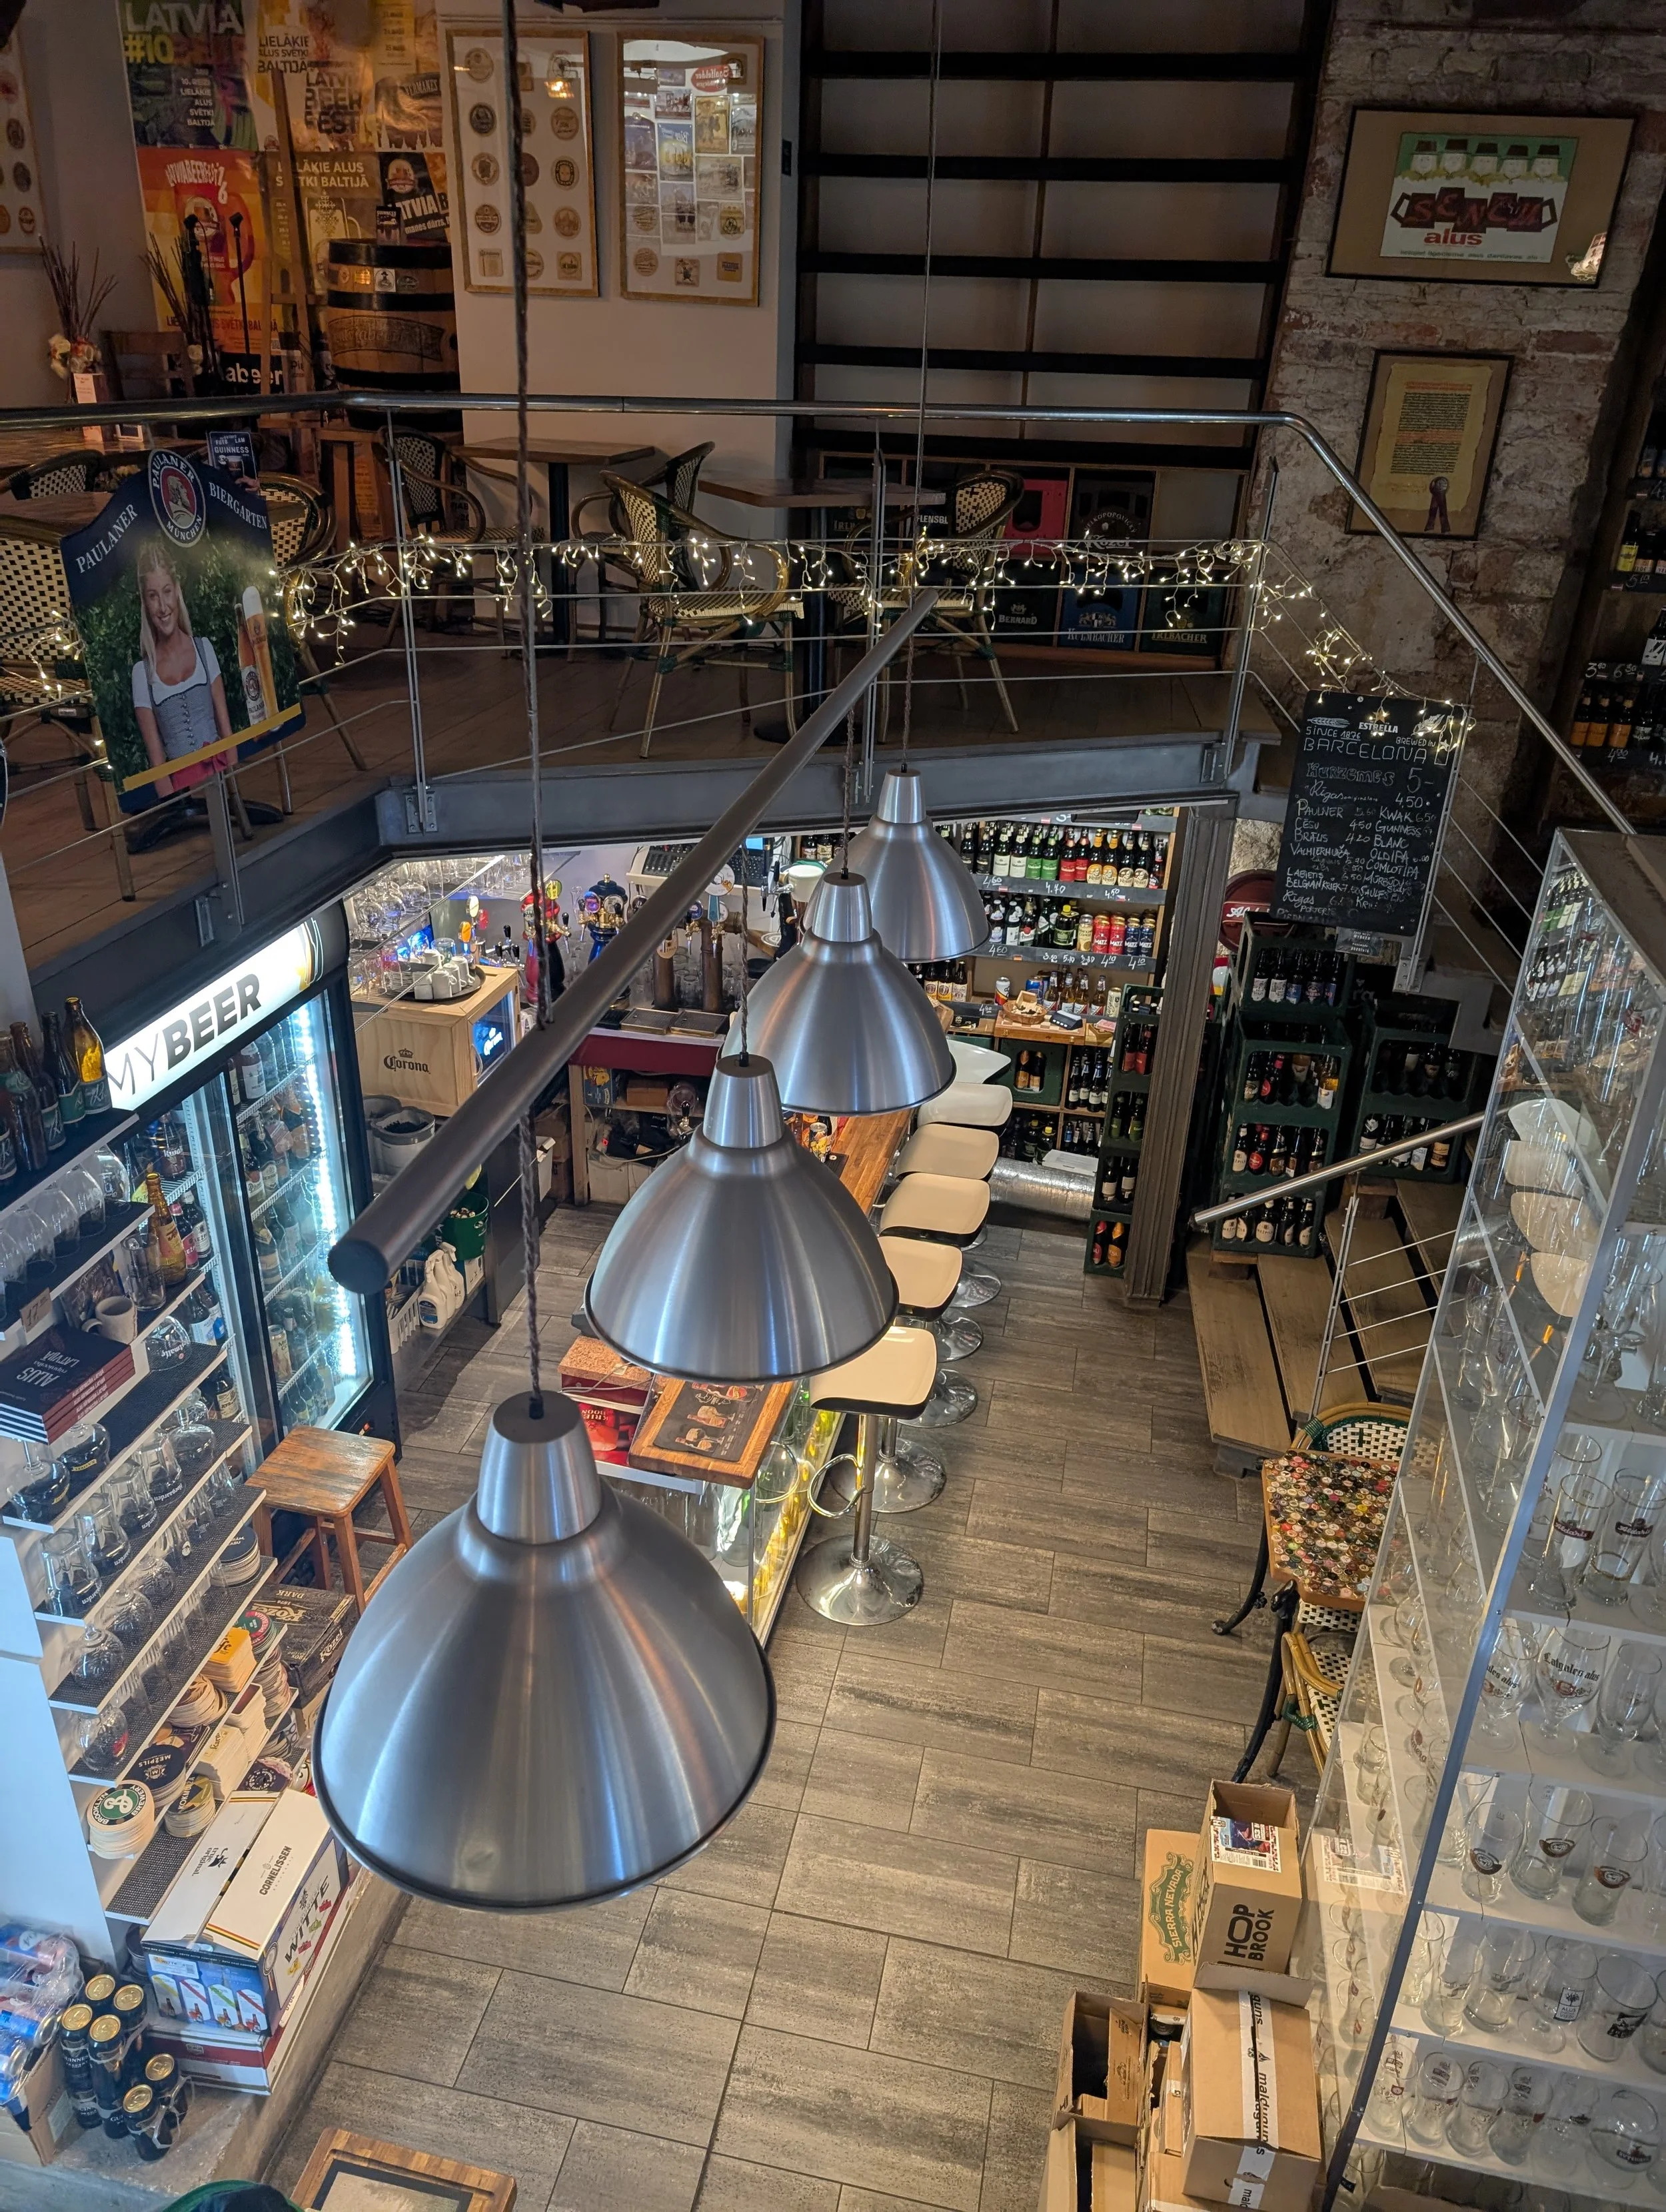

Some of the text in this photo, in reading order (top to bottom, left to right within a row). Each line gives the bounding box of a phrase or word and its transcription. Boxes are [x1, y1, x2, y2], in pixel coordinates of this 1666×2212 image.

[126, 3, 243, 33] LATVIA
[123, 34, 175, 63] #10
[333, 161, 364, 173] ALUS
[321, 175, 369, 187] BALTIJĀ
[1423, 229, 1483, 245] alus
[152, 454, 195, 489] PAULANER
[208, 481, 268, 530] BIERGARTEN
[76, 504, 139, 574] PAULANER
[166, 514, 203, 541] MÜNCHEN
[998, 613, 1038, 626] BERNARD
[1066, 628, 1126, 644] KULMBACHER
[1340, 730, 1361, 741] 1876
[1358, 722, 1398, 734] ESTRELLA
[1395, 736, 1426, 747] BREWED
[1303, 737, 1427, 764] BARCELONA
[1379, 806, 1413, 823] KWAK
[384, 1055, 431, 1074] Corona
[16, 1367, 61, 1387] ALUS
[277, 1590, 306, 1599] DARK
[319, 1628, 344, 1664] Kozel
[1543, 1652, 1601, 1682] Latgales alus
[1501, 1676, 1519, 1689] alus
[93, 1792, 109, 1826] BROOKLYN
[129, 1784, 147, 1817] BREWERY
[259, 1846, 293, 1896] CORNELISSEN
[285, 1874, 330, 1963] WITTE
[1163, 1868, 1182, 1949] SIERRA NEVADA
[1224, 1904, 1256, 1959] HOP
[1248, 1908, 1275, 1962] BROOK
